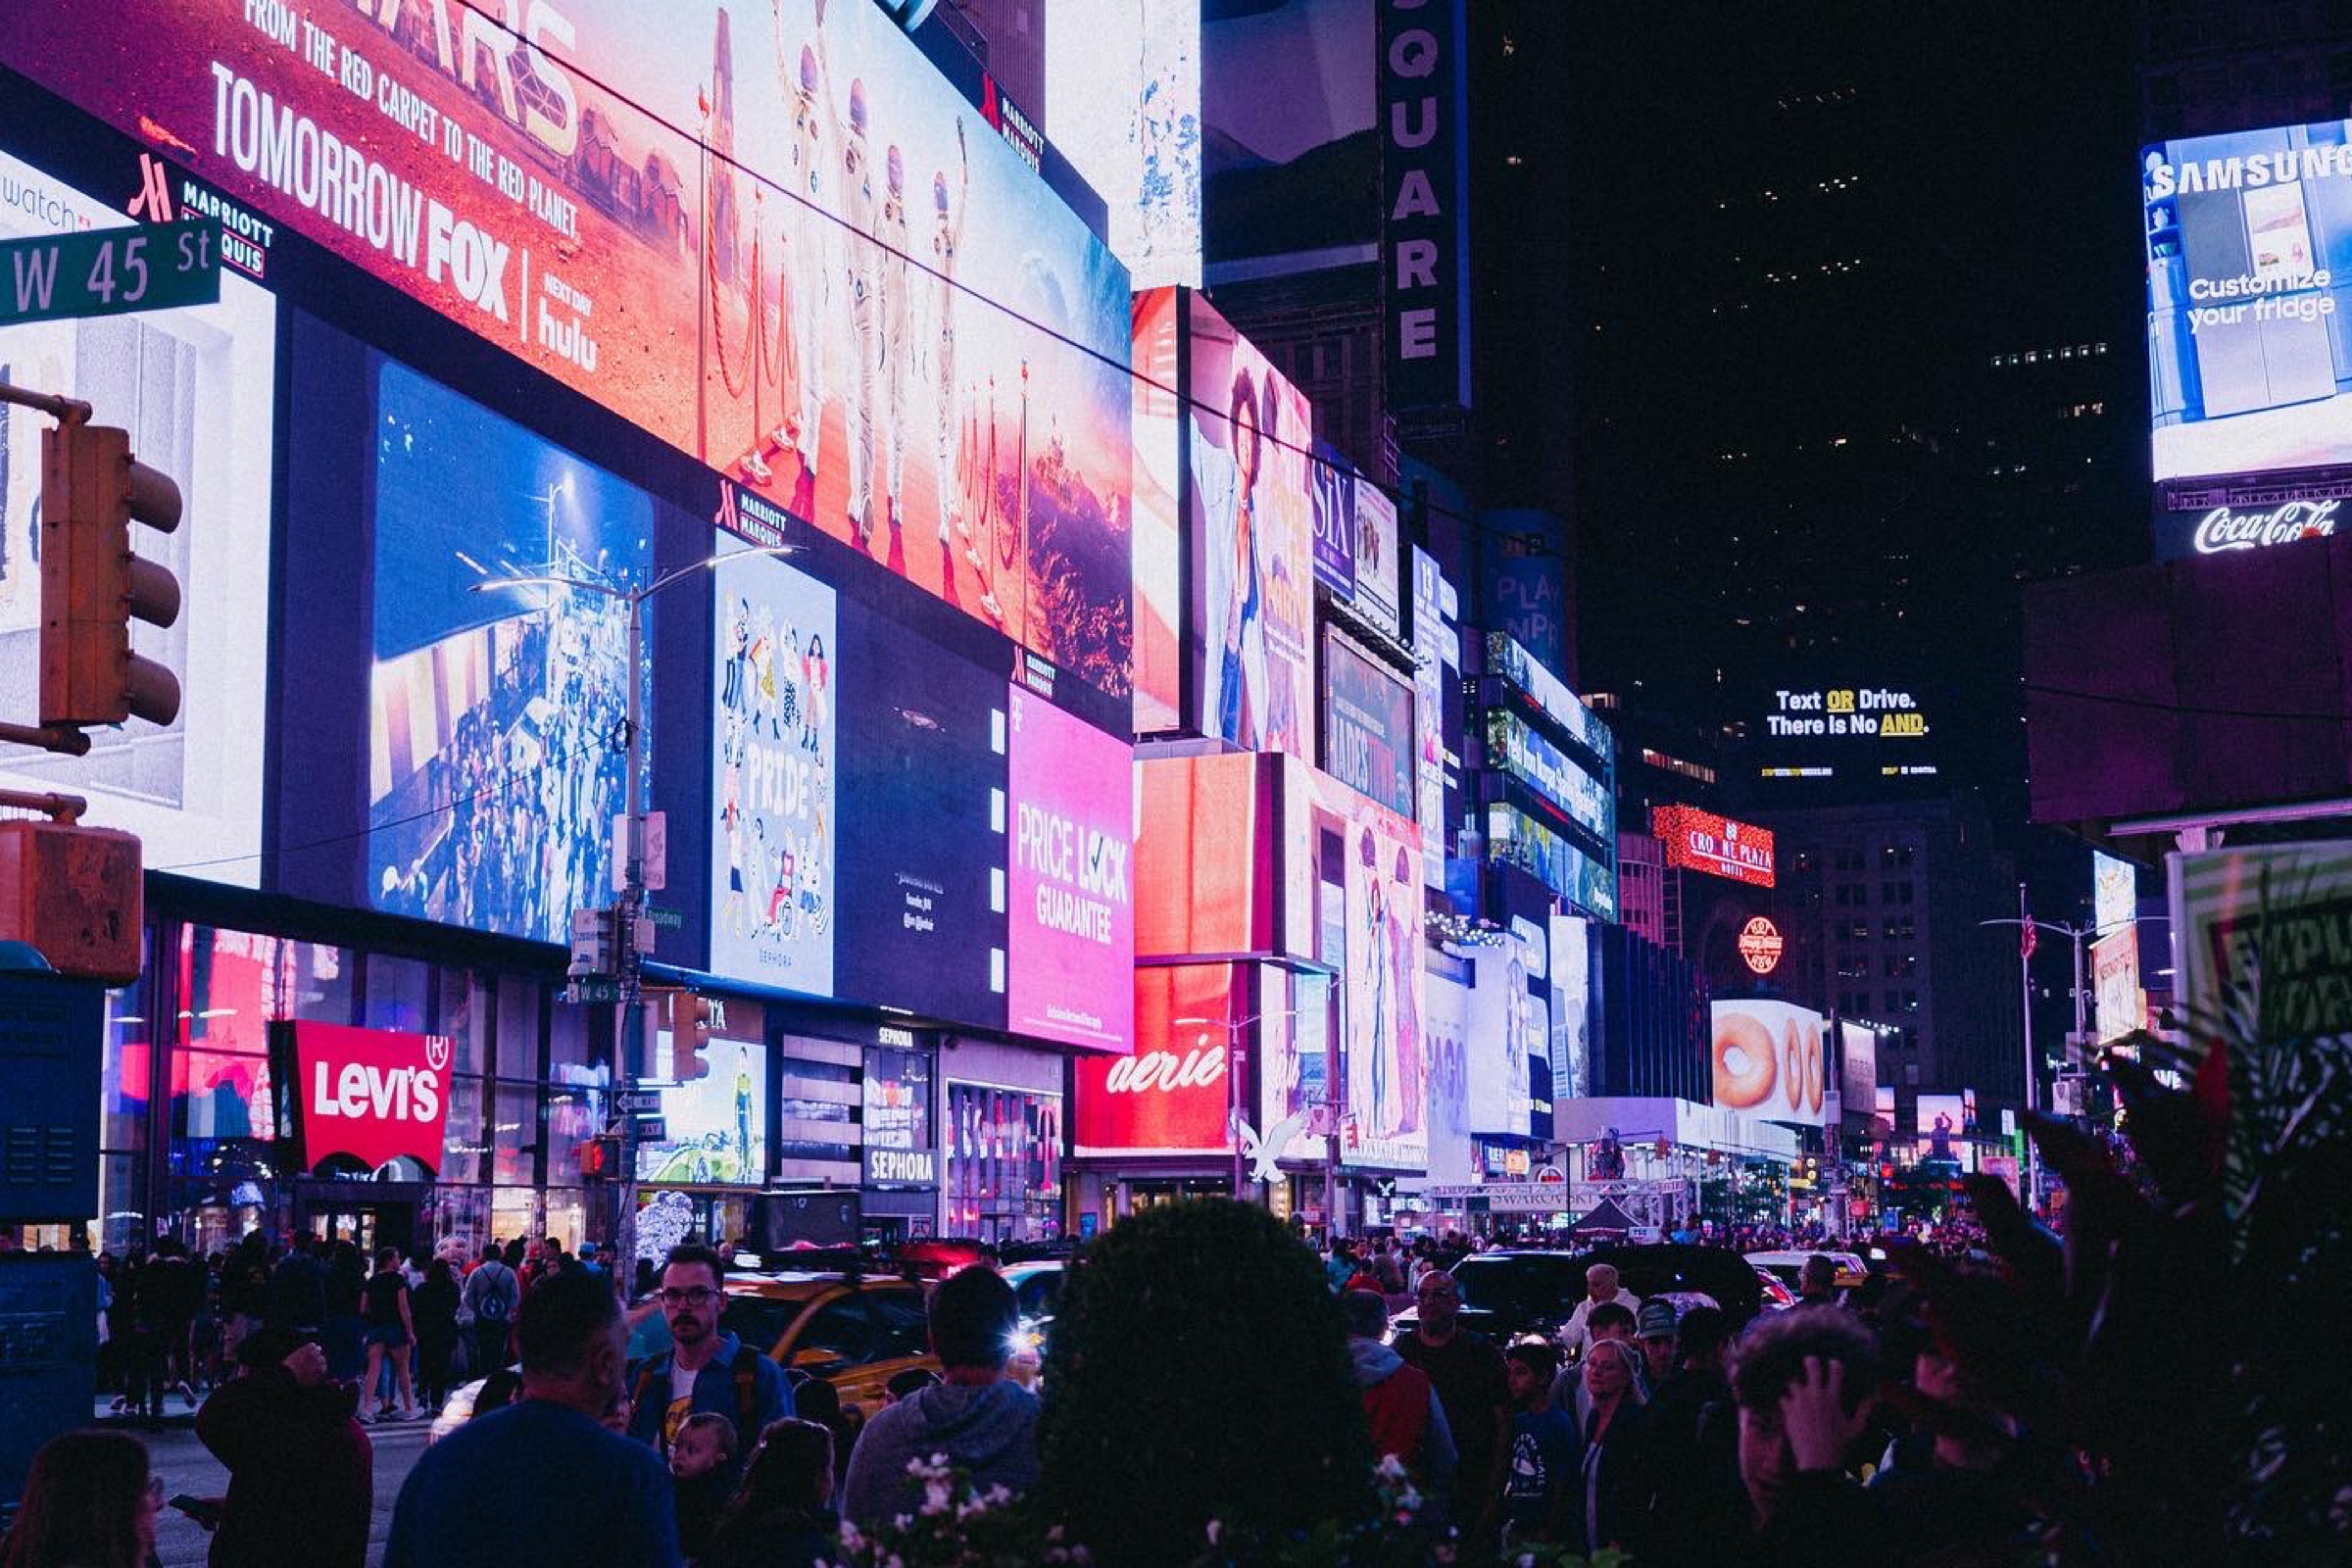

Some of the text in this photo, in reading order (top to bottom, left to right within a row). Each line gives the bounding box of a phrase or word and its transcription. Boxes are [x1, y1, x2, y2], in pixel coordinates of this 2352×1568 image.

[244, 0, 578, 238] FROM THE RED CARPET TO THE RED PLANET
[212, 61, 510, 323] TOMORROW FOX
[1387, 0, 1441, 360] QUARE
[183, 180, 274, 247] MARRIOTT
[13, 229, 210, 313] W 45 St
[544, 271, 593, 318] NEXT DAY
[2188, 270, 2332, 300] Customize
[539, 296, 598, 373] hulu
[2187, 295, 2336, 334] your fridge
[741, 493, 787, 531] MARRIOTT
[1767, 715, 1825, 736] There
[1850, 714, 1878, 734] No
[1880, 713, 1930, 736] AND.
[1776, 688, 1917, 712] Text OR Drive.
[748, 741, 809, 820] PRIDE
[1018, 801, 1073, 883] PRICE
[1740, 844, 1773, 869] PLAZA
[1036, 883, 1112, 945] GUARANTEE
[1105, 1033, 1228, 1095] aerie
[871, 1150, 934, 1181] SEPHORA
